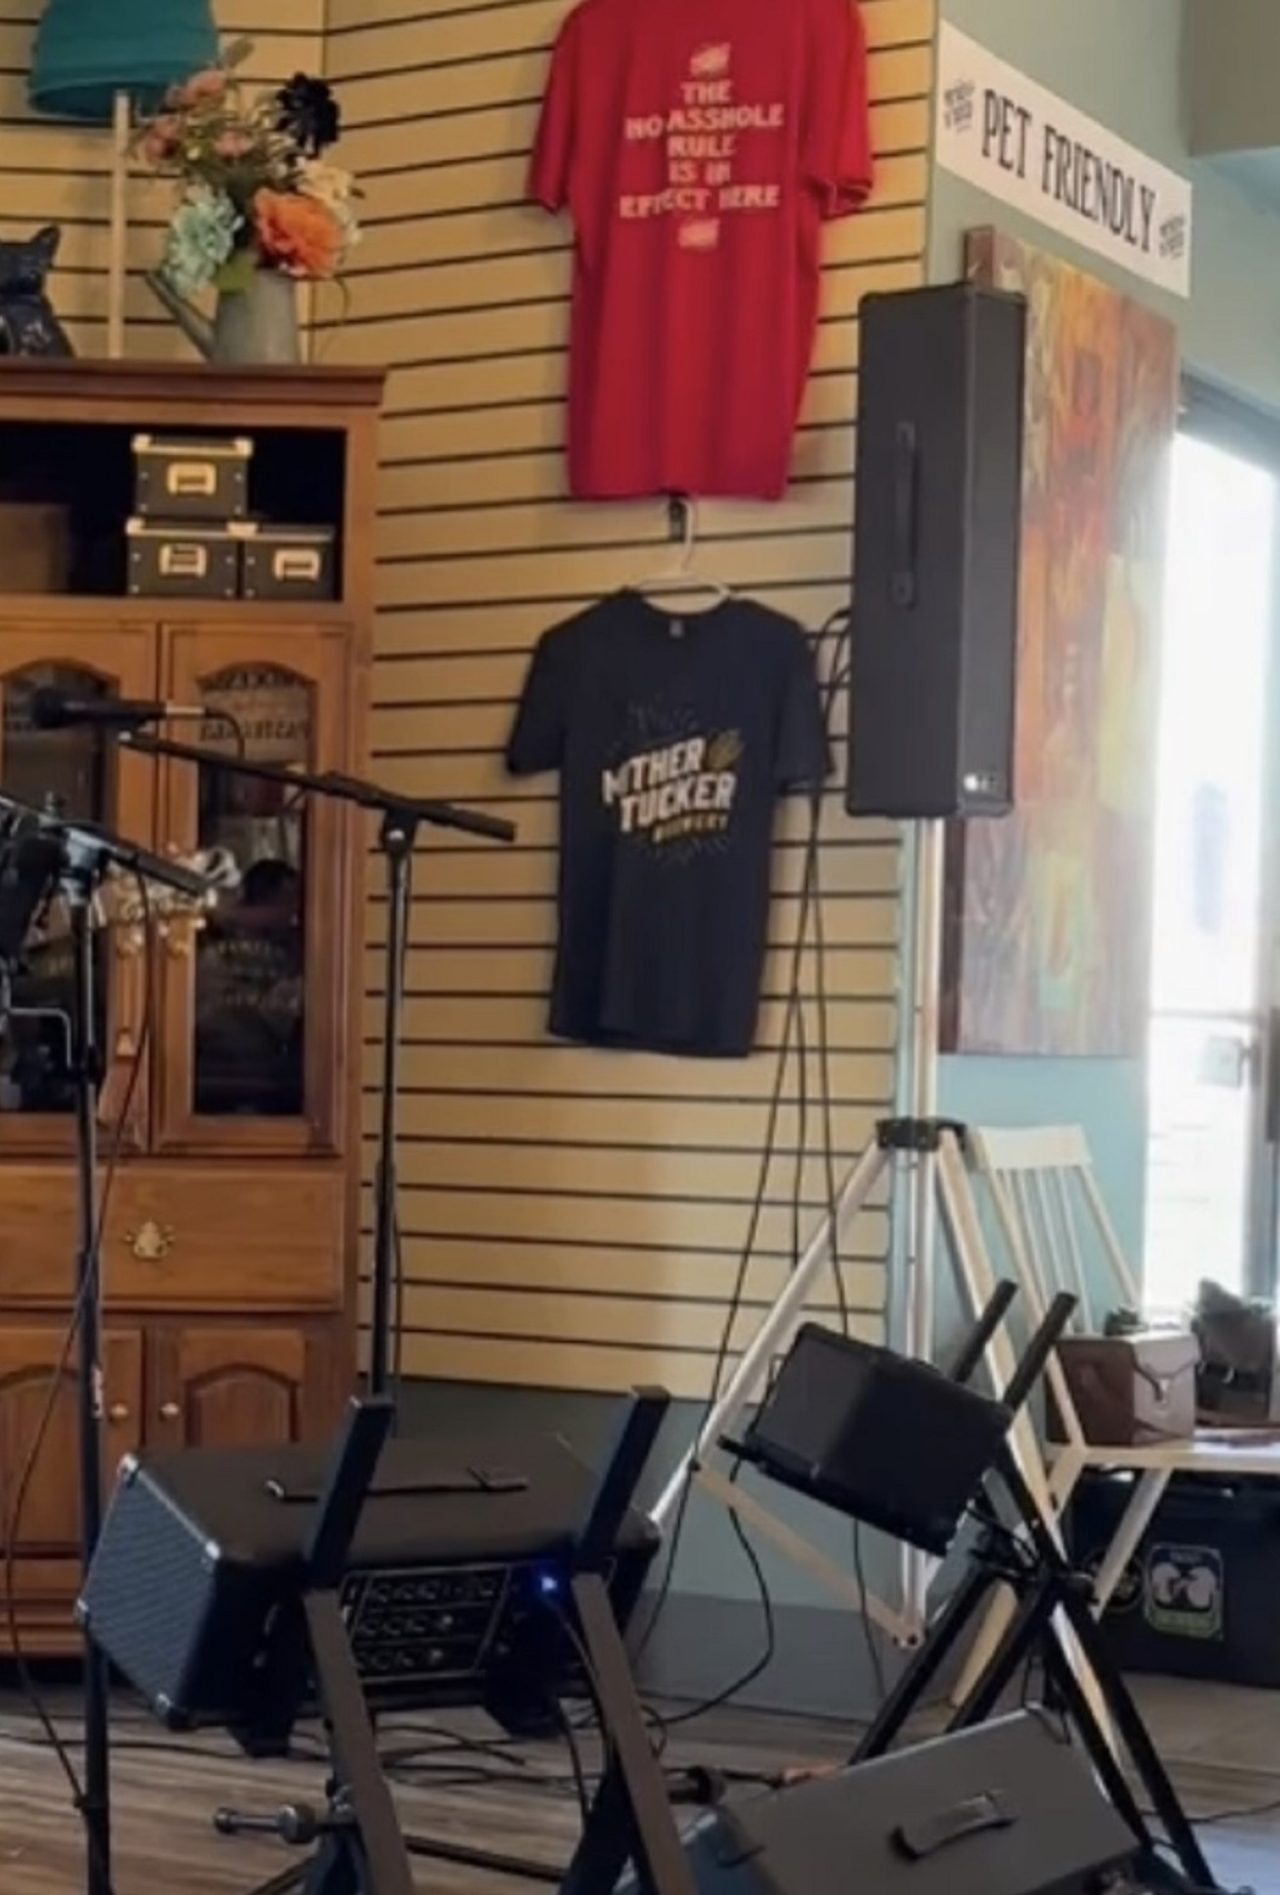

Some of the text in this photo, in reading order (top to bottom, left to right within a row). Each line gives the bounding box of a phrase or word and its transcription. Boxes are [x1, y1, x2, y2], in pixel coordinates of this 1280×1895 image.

[681, 80, 734, 104] THE
[625, 104, 784, 140] NO ASSHOLE
[668, 134, 736, 157] RULE
[670, 161, 731, 184] IS IN
[981, 88, 1034, 179] PET
[1041, 123, 1156, 253] FRIENDLY
[620, 185, 780, 219] EFFECT HERE
[603, 738, 705, 804] MTHER
[621, 771, 736, 833] TUCKER
